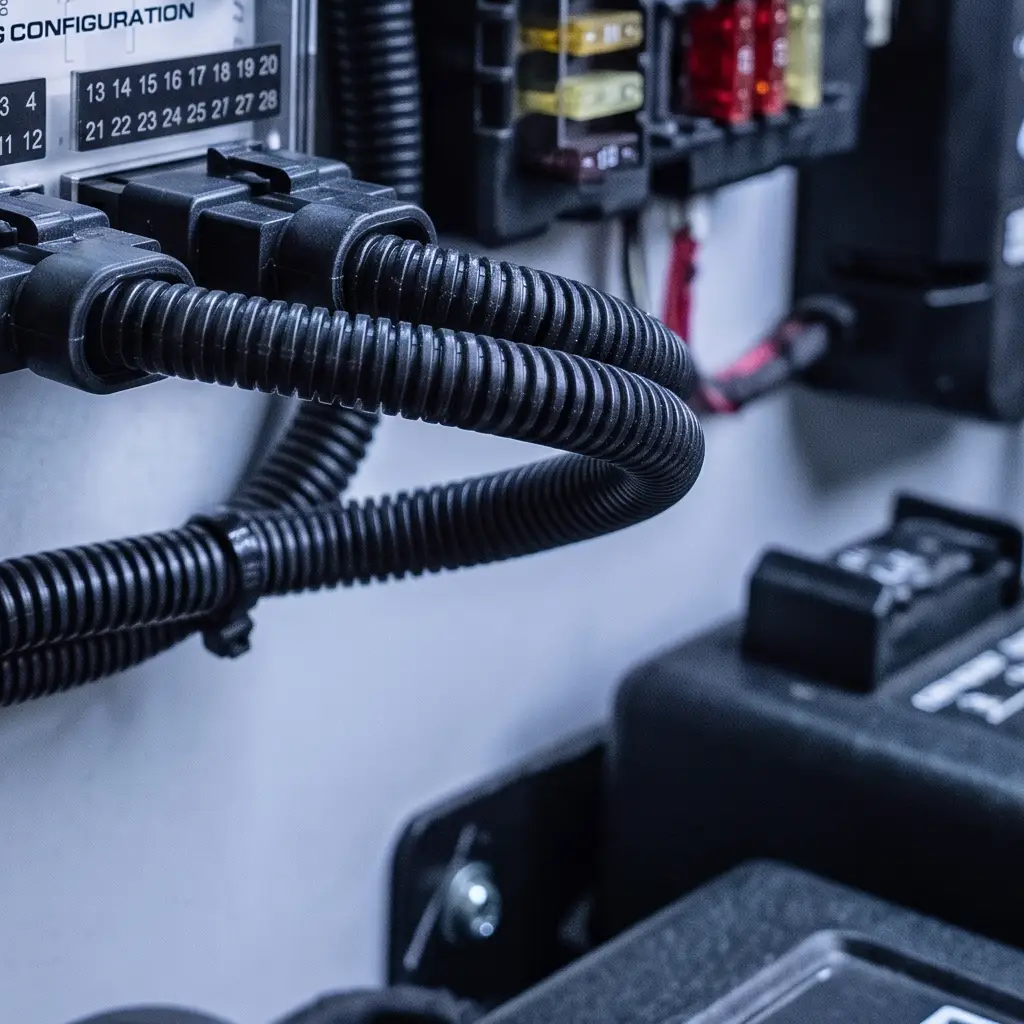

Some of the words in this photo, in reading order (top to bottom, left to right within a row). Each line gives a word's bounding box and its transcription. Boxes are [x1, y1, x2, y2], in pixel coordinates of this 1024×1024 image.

[10, 2, 195, 42] CONFIGURATION
[86, 81, 106, 103] 13
[112, 76, 132, 99] 14
[139, 73, 158, 95] 15
[163, 69, 182, 91] 16
[188, 65, 207, 87] 17
[212, 61, 231, 83] 18
[236, 57, 255, 79] 19
[258, 53, 278, 77] 20
[0, 96, 10, 116] 3
[26, 91, 37, 111] 4
[85, 119, 104, 142] 21
[111, 115, 131, 137] 22
[137, 111, 157, 133] 23
[162, 106, 182, 129] 24
[186, 101, 207, 124] 25
[234, 92, 255, 116] 27
[23, 129, 42, 151] 12
